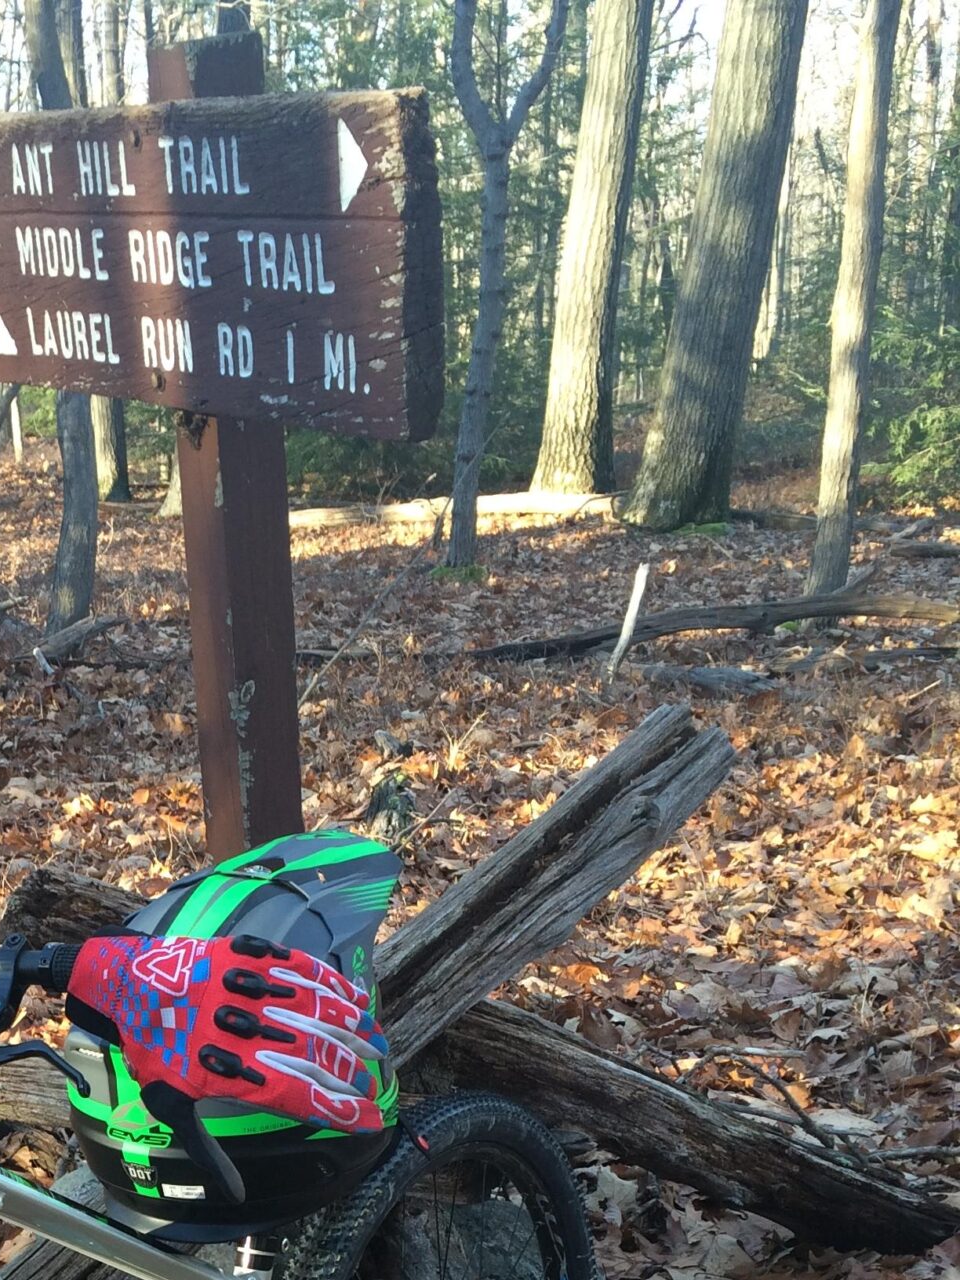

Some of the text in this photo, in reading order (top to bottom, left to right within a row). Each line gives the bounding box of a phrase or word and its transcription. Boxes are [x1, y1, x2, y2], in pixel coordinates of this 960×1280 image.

[11, 135, 251, 197] ANT HILL TRAIL
[15, 226, 335, 294] MIDDLE RIDGE TRAIL
[25, 307, 120, 364] LAUREL
[141, 316, 193, 373] RUN
[218, 322, 254, 378] RD
[324, 332, 371, 395] MI.
[128, 1167, 152, 1181] DOT
